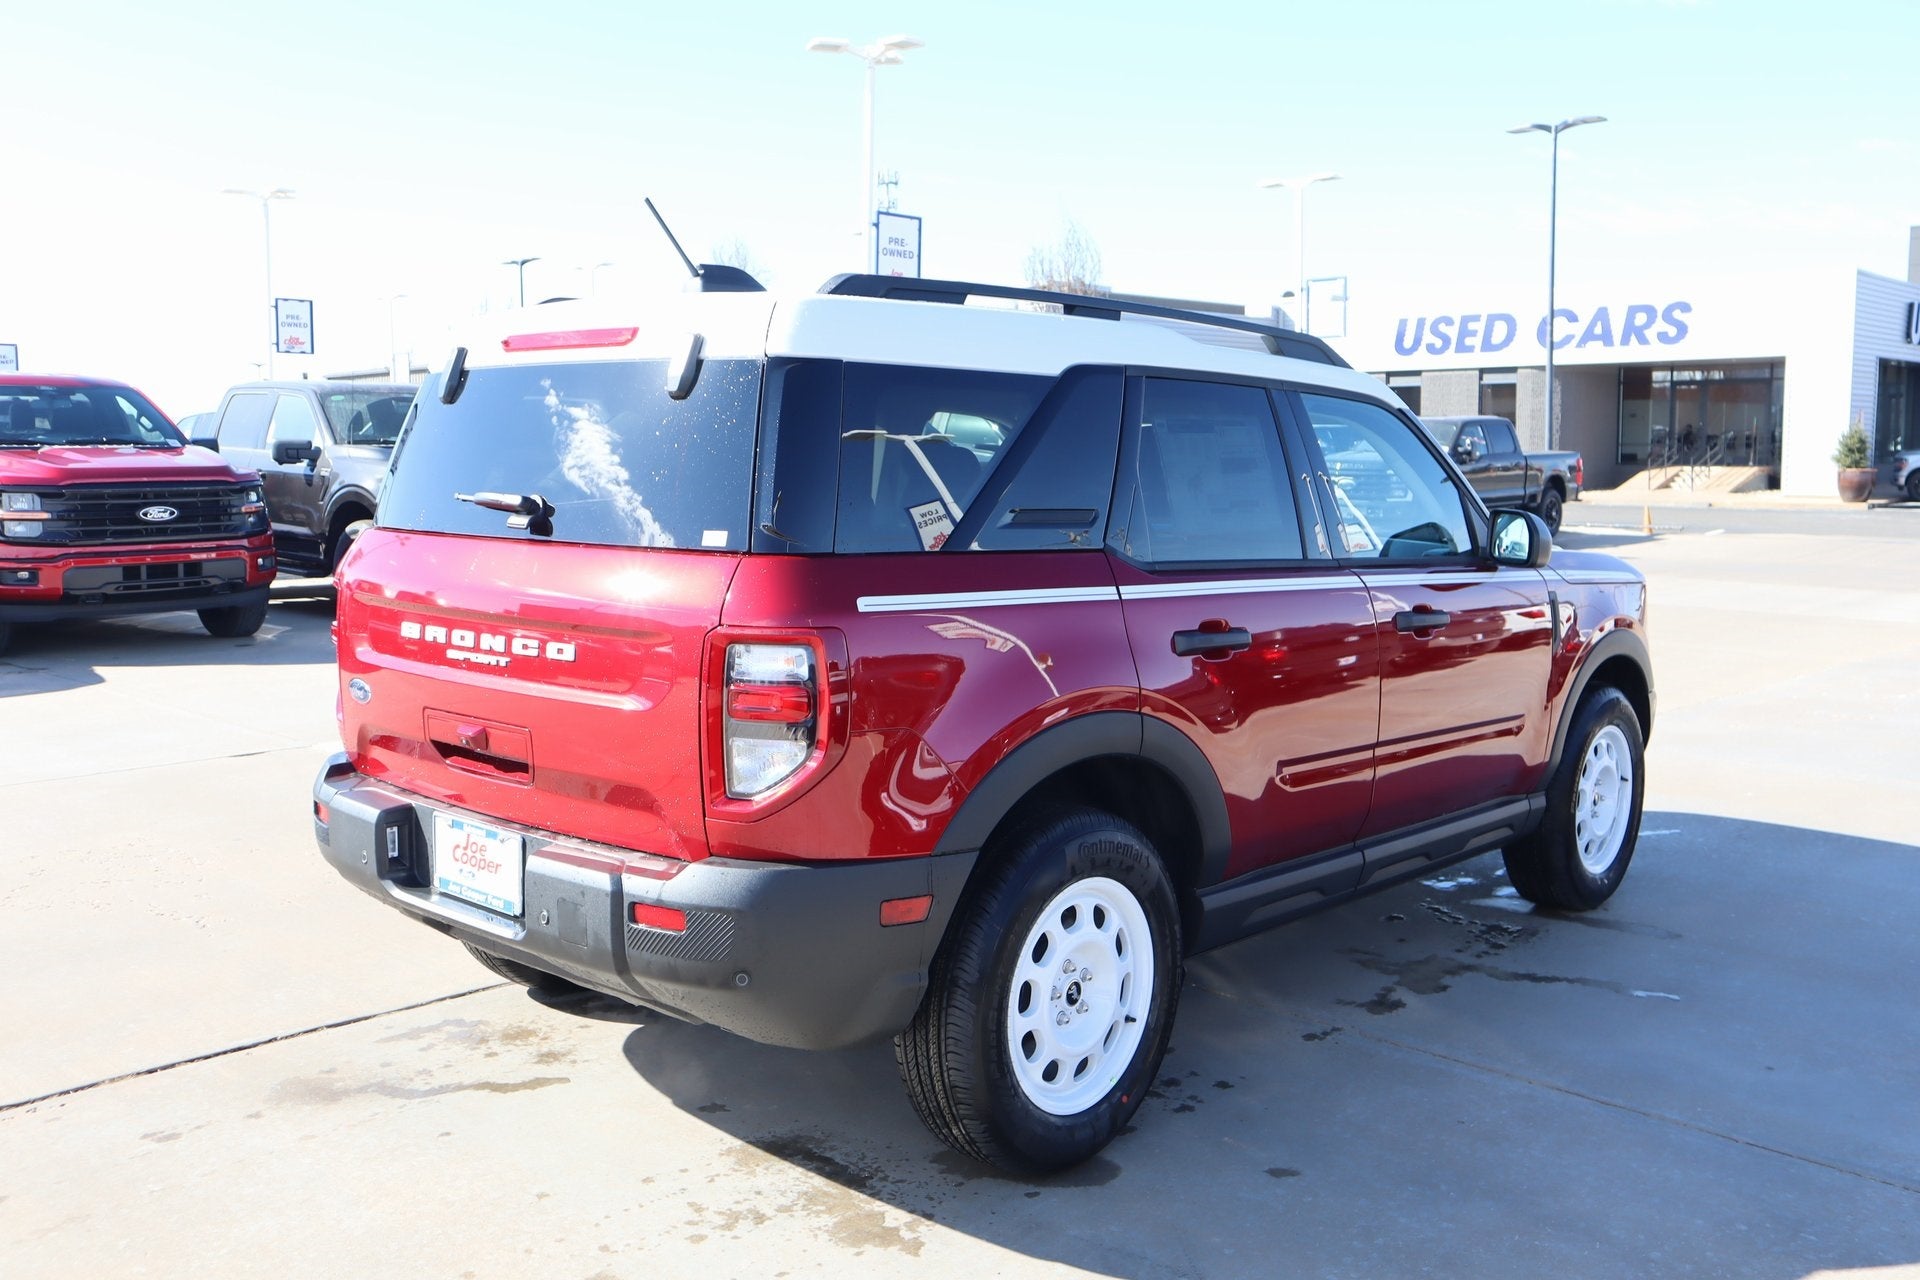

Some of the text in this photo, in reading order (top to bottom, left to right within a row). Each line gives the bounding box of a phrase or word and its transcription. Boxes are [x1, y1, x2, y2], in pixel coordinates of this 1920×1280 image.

[888, 236, 908, 247] PRE-
[881, 247, 915, 260] OWNED
[1394, 301, 1693, 356] USED CARS
[145, 507, 171, 519] Ford
[400, 620, 577, 662] BRONCO
[446, 649, 511, 667] SPORT
[462, 833, 487, 857] Joe
[452, 844, 502, 874] Cooper
